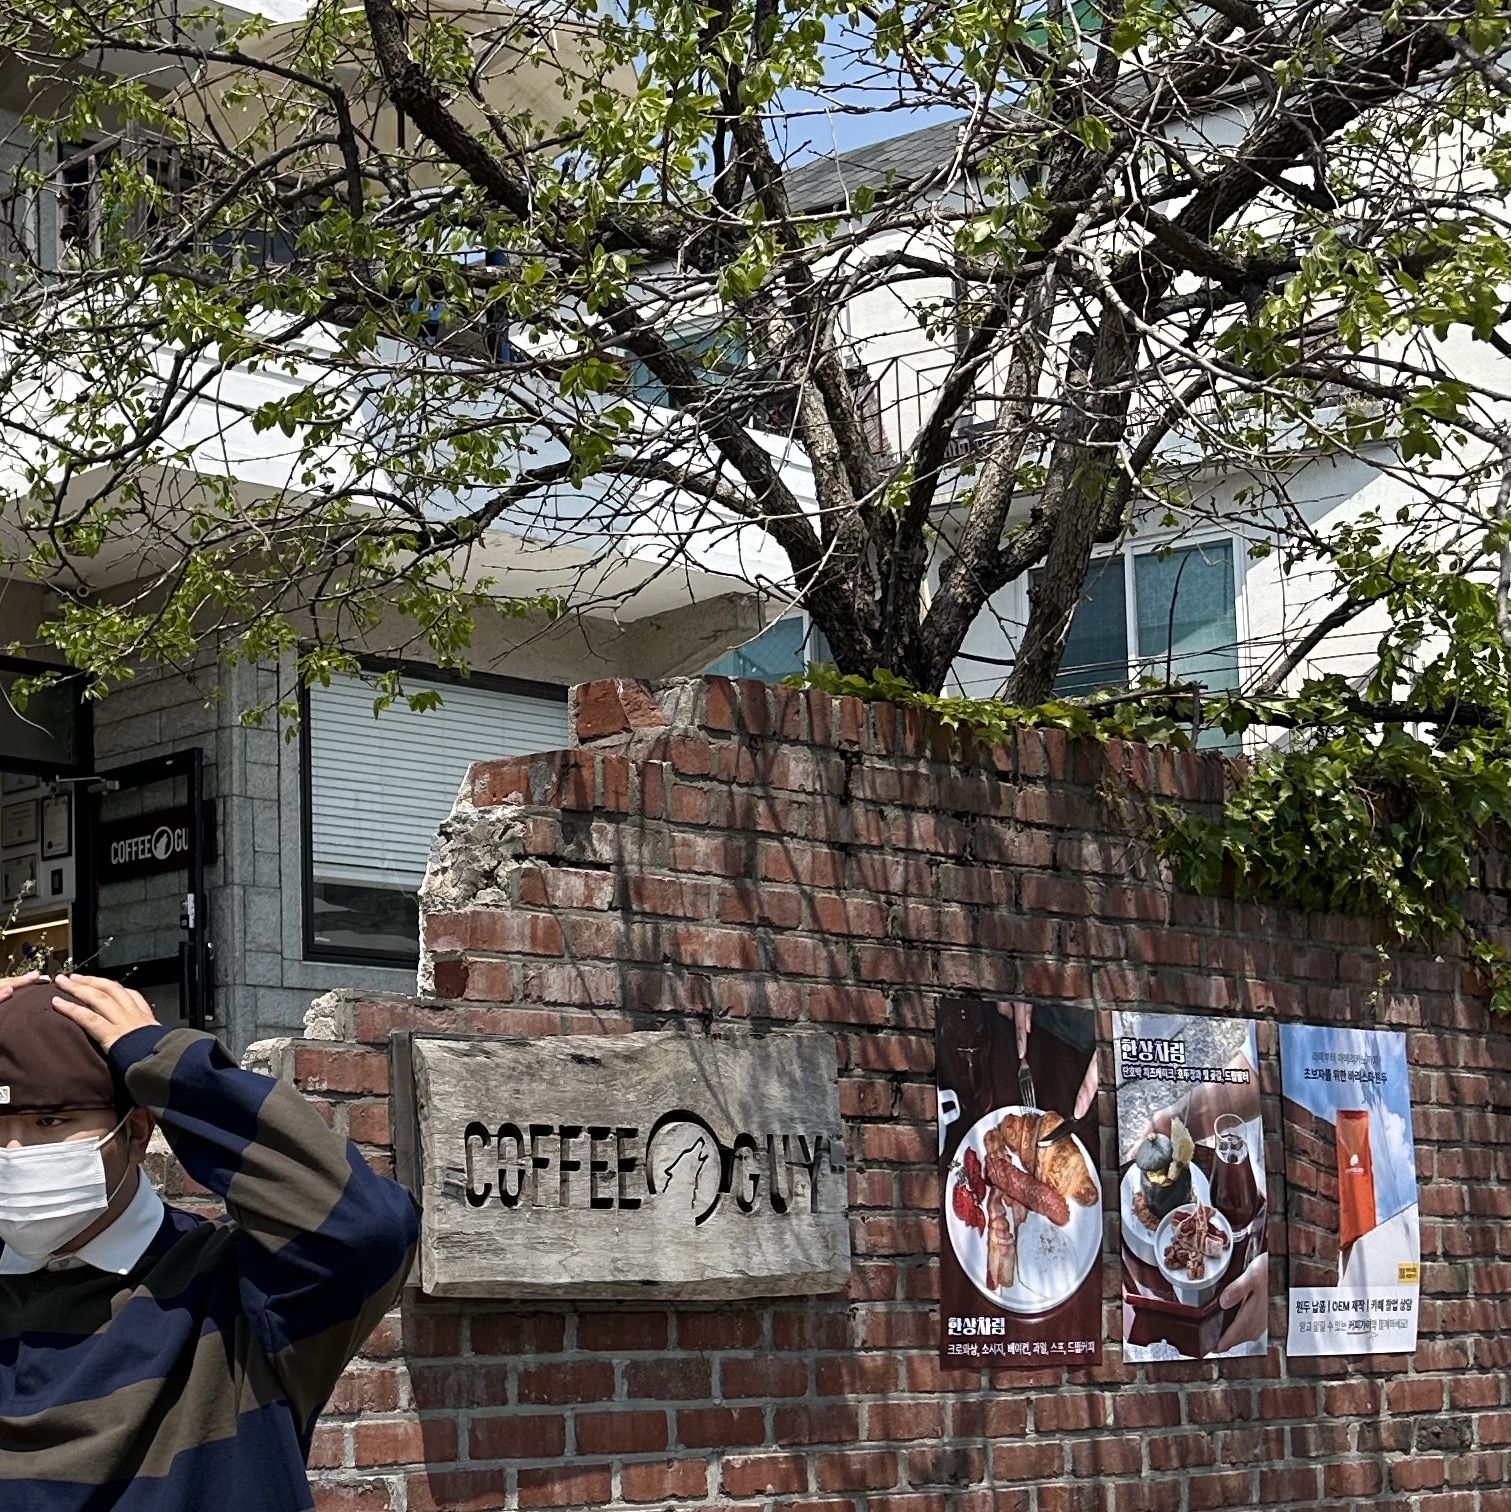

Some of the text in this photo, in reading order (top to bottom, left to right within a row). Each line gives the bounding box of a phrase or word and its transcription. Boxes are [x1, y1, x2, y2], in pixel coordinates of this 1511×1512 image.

[111, 827, 189, 865] COFFEE GU
[1121, 1038, 1185, 1063] 한상차림
[1304, 1068, 1332, 1082] 초보자를
[1333, 1069, 1347, 1082] 위한
[464, 1121, 824, 1214] COFFEE GUY
[1296, 1300, 1310, 1313] 원두
[1311, 1300, 1326, 1313] 납품
[1332, 1301, 1350, 1312] OEM
[948, 1317, 1006, 1336] 한상차림
[981, 1342, 1006, 1357] 소시지,
